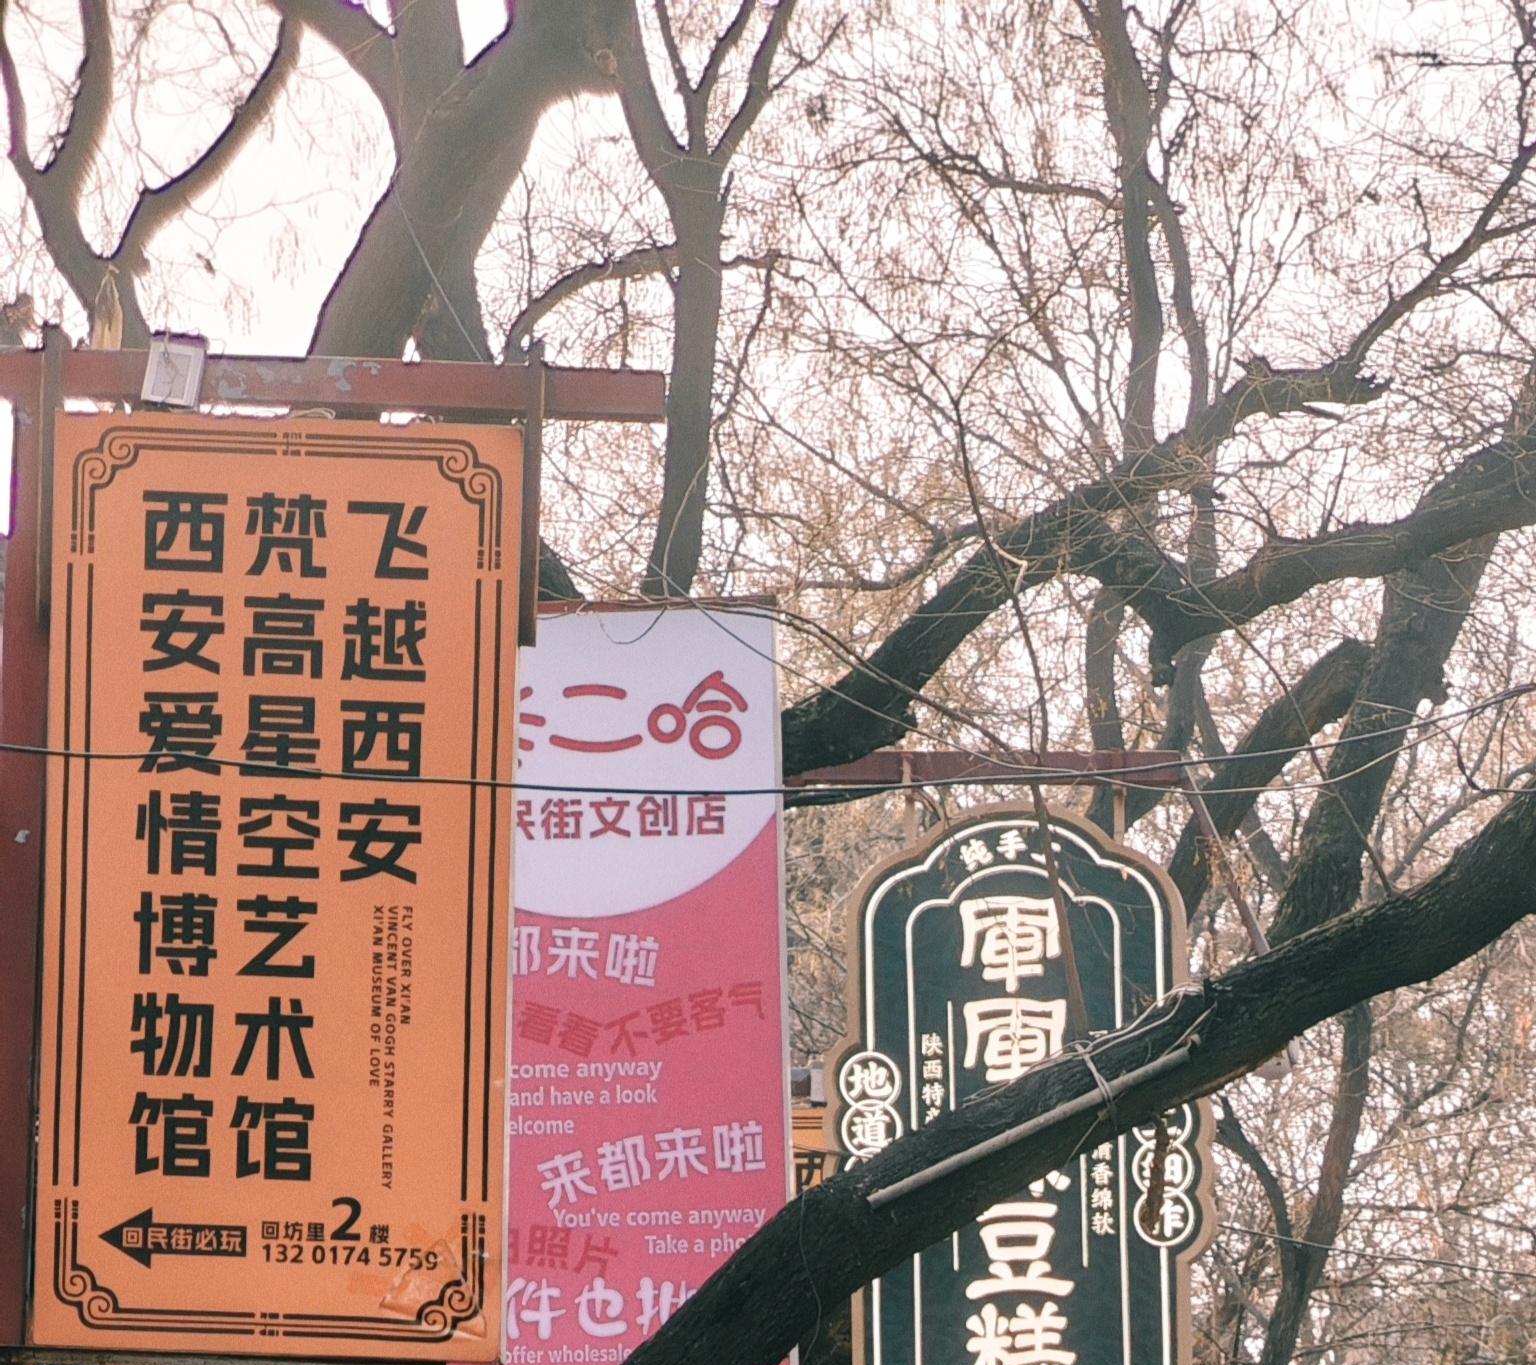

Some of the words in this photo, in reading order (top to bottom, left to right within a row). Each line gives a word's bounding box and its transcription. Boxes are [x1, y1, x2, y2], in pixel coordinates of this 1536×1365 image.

[338, 500, 430, 885] 飞越西安
[130, 489, 227, 1180] 西安爱情博物馆
[228, 493, 328, 1183] 梵高星空艺术馆
[386, 905, 399, 970] VINCENT
[402, 905, 413, 930] FLY
[402, 936, 413, 978] OVER
[371, 952, 383, 1017] MUSEUM
[385, 977, 397, 1008] VAN
[370, 1023, 381, 1043] OF
[384, 1012, 396, 1057] GOGH
[517, 980, 766, 1058] 看看不要客气
[369, 1049, 380, 1087] LOVE
[576, 1060, 663, 1082] anyway
[383, 1061, 395, 1119] STARRY
[551, 1085, 594, 1106] have
[600, 1089, 611, 1104] a
[616, 1083, 658, 1104] look
[508, 1115, 575, 1136] elcome
[381, 1124, 393, 1190] GALLERY
[537, 1120, 767, 1209] 来都来啦
[553, 1207, 620, 1229] You've
[627, 1210, 682, 1227] come
[688, 1207, 767, 1229] anyway
[122, 1226, 243, 1253] 回民街必玩
[262, 1243, 304, 1265] 132
[312, 1244, 371, 1267] 0174
[379, 1247, 439, 1271] 5759
[644, 1235, 689, 1255] Take
[693, 1238, 705, 1253] a
[711, 1232, 750, 1258] pho
